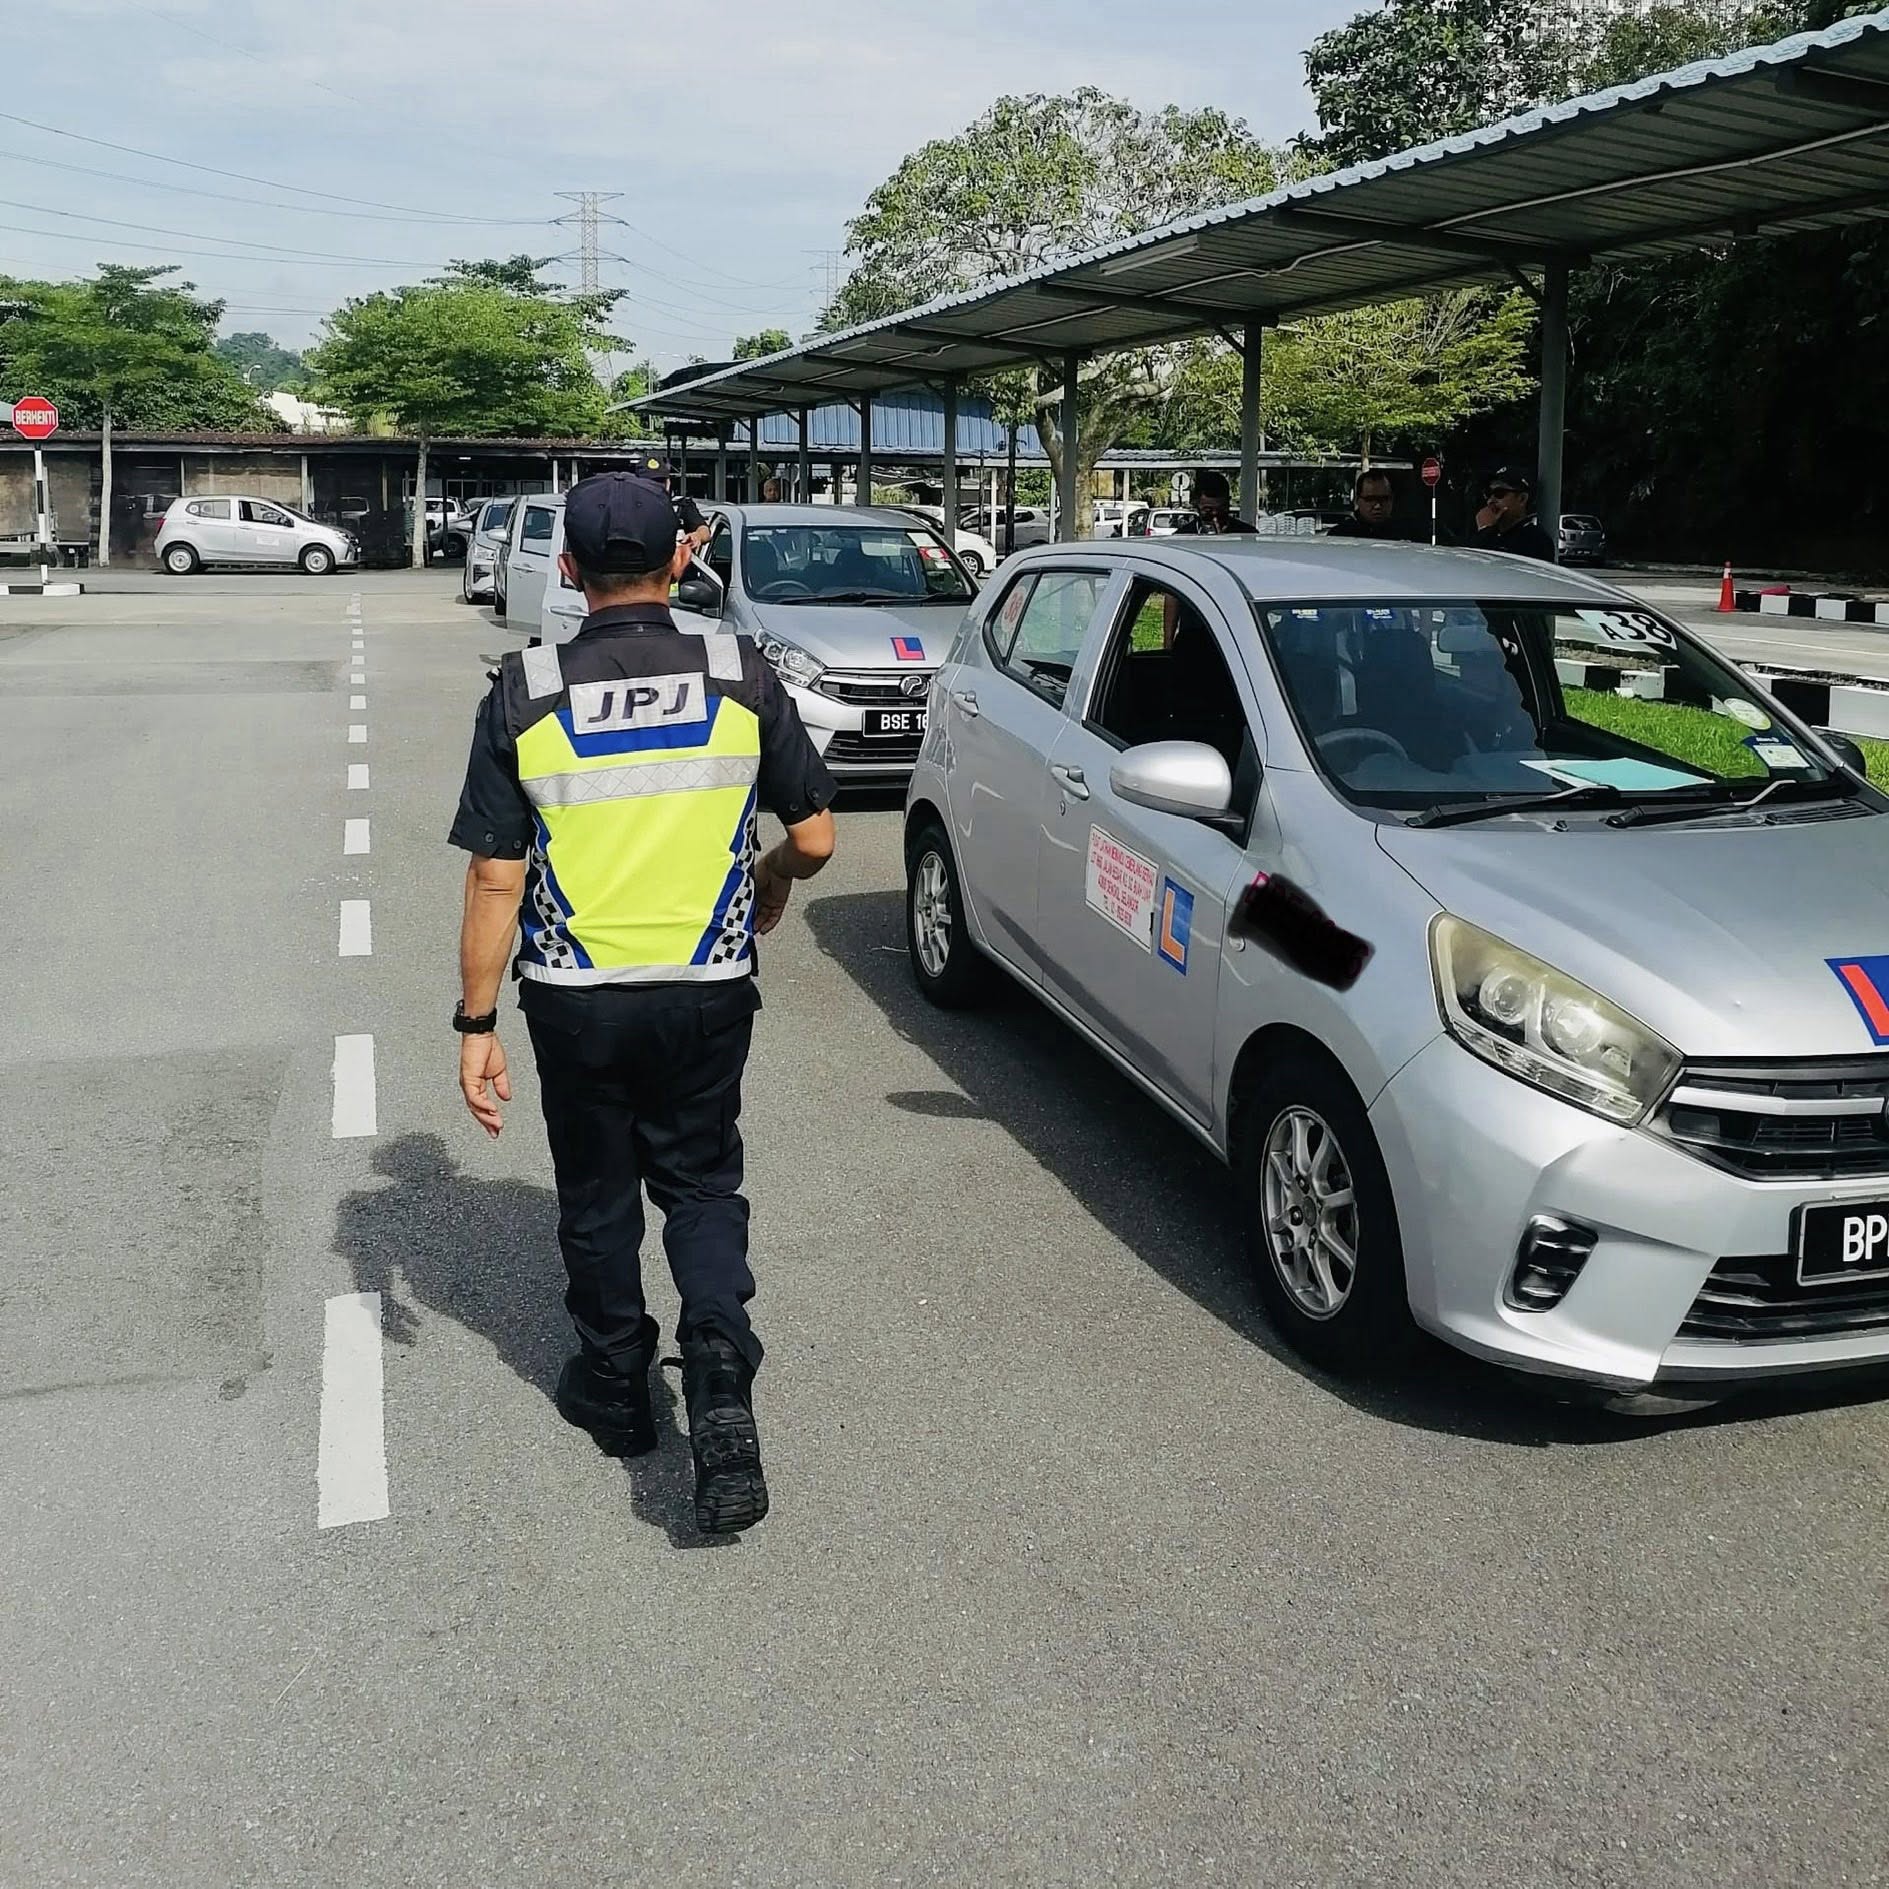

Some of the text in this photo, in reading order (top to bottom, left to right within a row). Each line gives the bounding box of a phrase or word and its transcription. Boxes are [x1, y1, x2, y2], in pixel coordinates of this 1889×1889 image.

[15, 410, 55, 425] BERHENTI
[1599, 611, 1672, 644] A38
[587, 683, 689, 723] JPJ
[881, 714, 910, 730] BSE
[1843, 1214, 1889, 1262] BP
